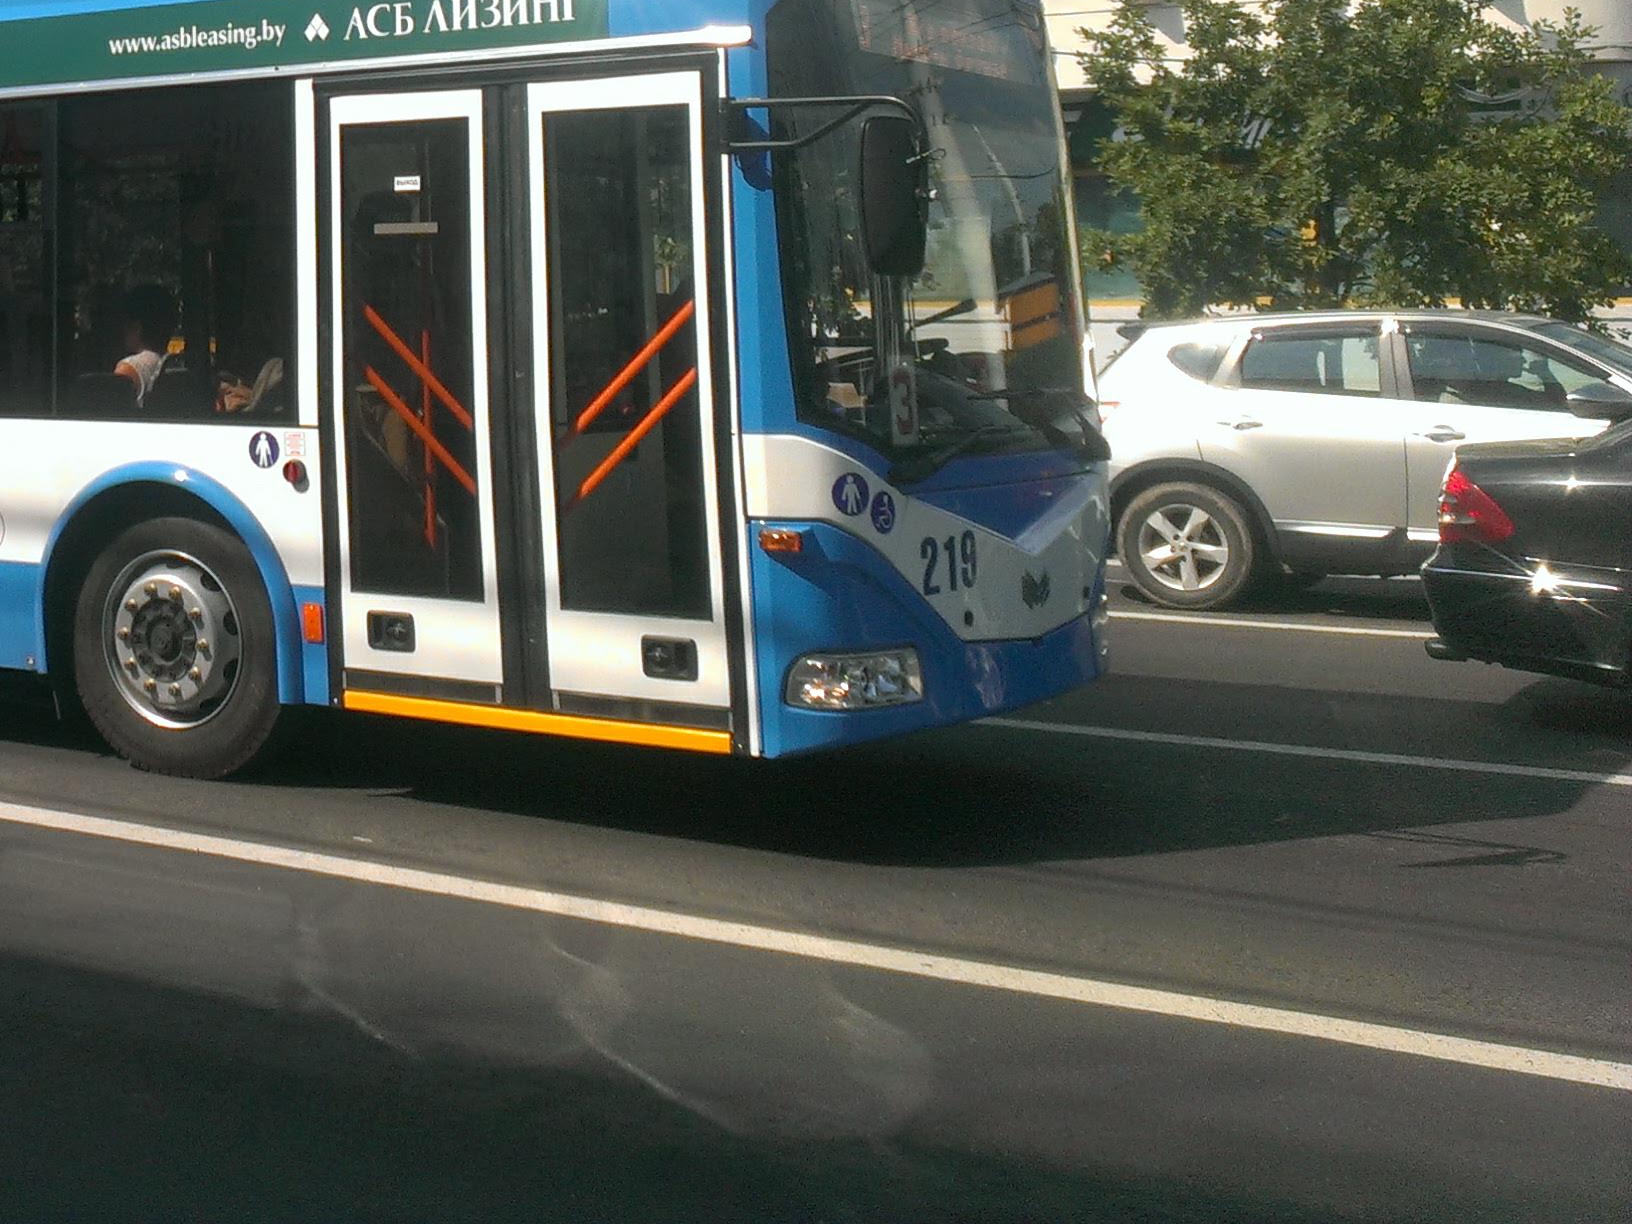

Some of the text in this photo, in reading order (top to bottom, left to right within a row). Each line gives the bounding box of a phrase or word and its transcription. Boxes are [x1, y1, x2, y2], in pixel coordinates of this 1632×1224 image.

[108, 18, 286, 55] www.asbleasing.by
[343, 1, 415, 41] АСБ
[919, 529, 978, 596] 219
